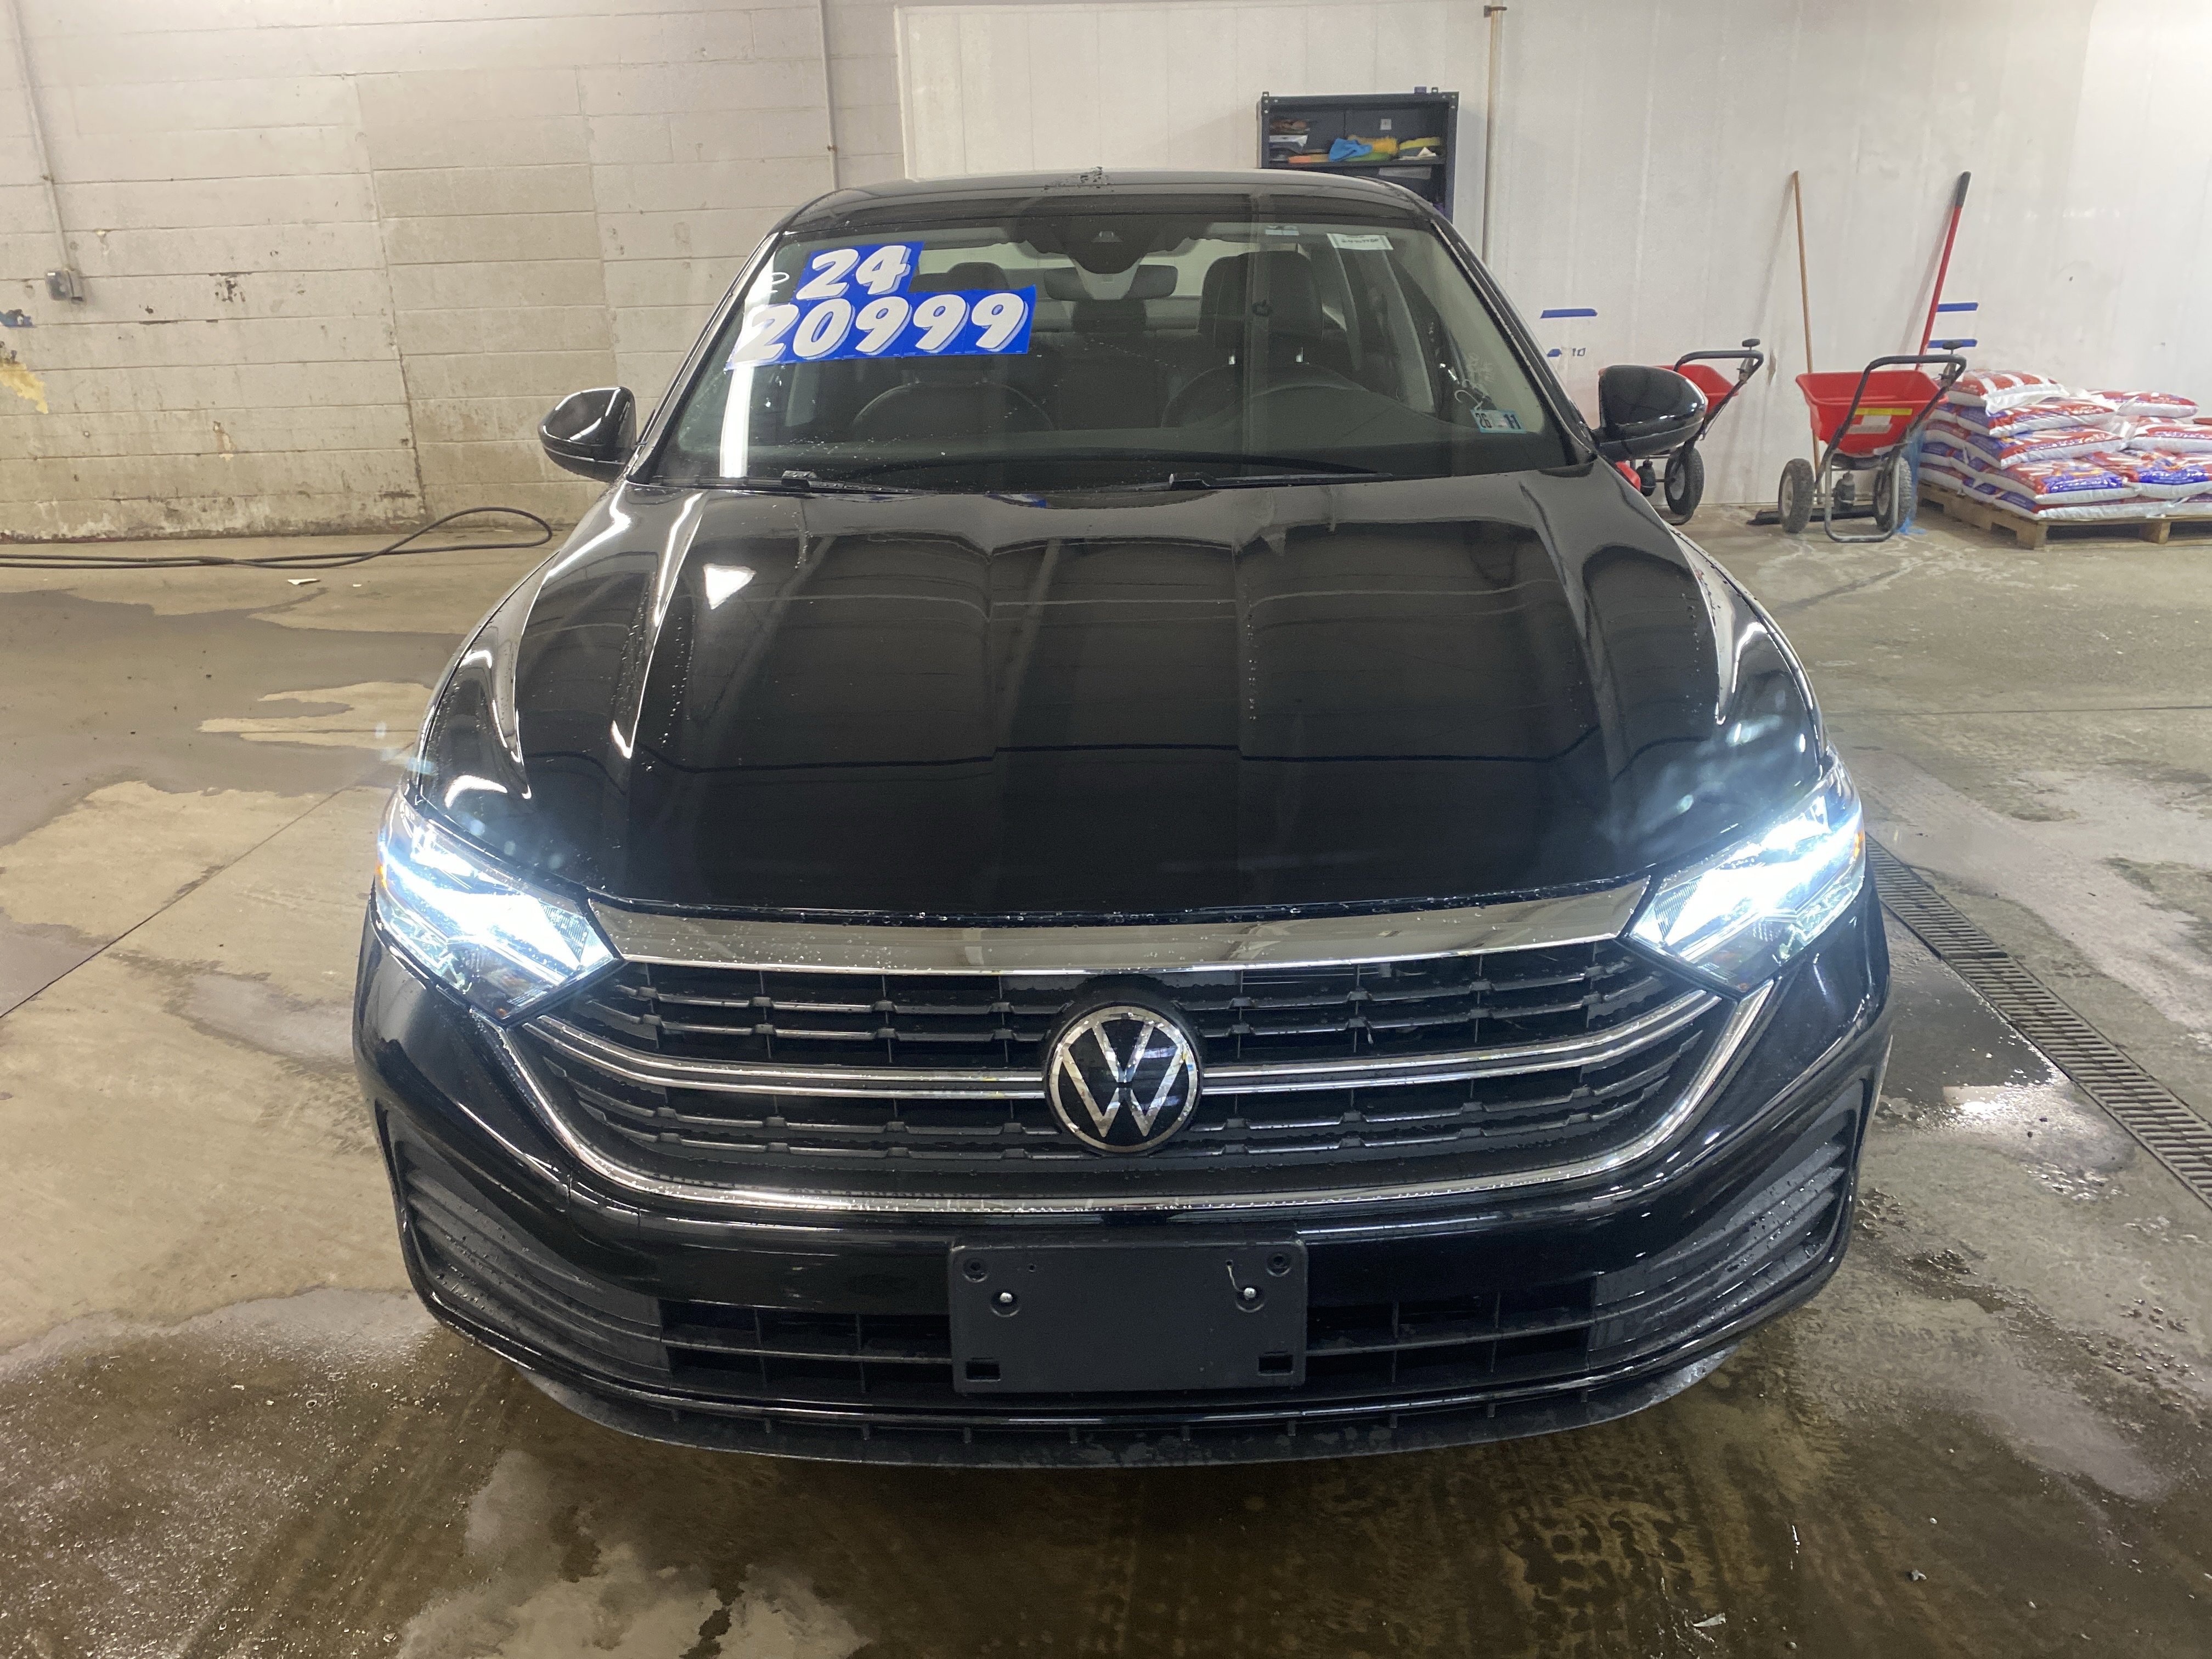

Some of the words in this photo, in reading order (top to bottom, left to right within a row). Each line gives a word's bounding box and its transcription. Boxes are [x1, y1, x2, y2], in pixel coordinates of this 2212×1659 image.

[796, 245, 911, 300] 24
[733, 292, 1029, 363] 20999
[1056, 1014, 1189, 1138] VW
